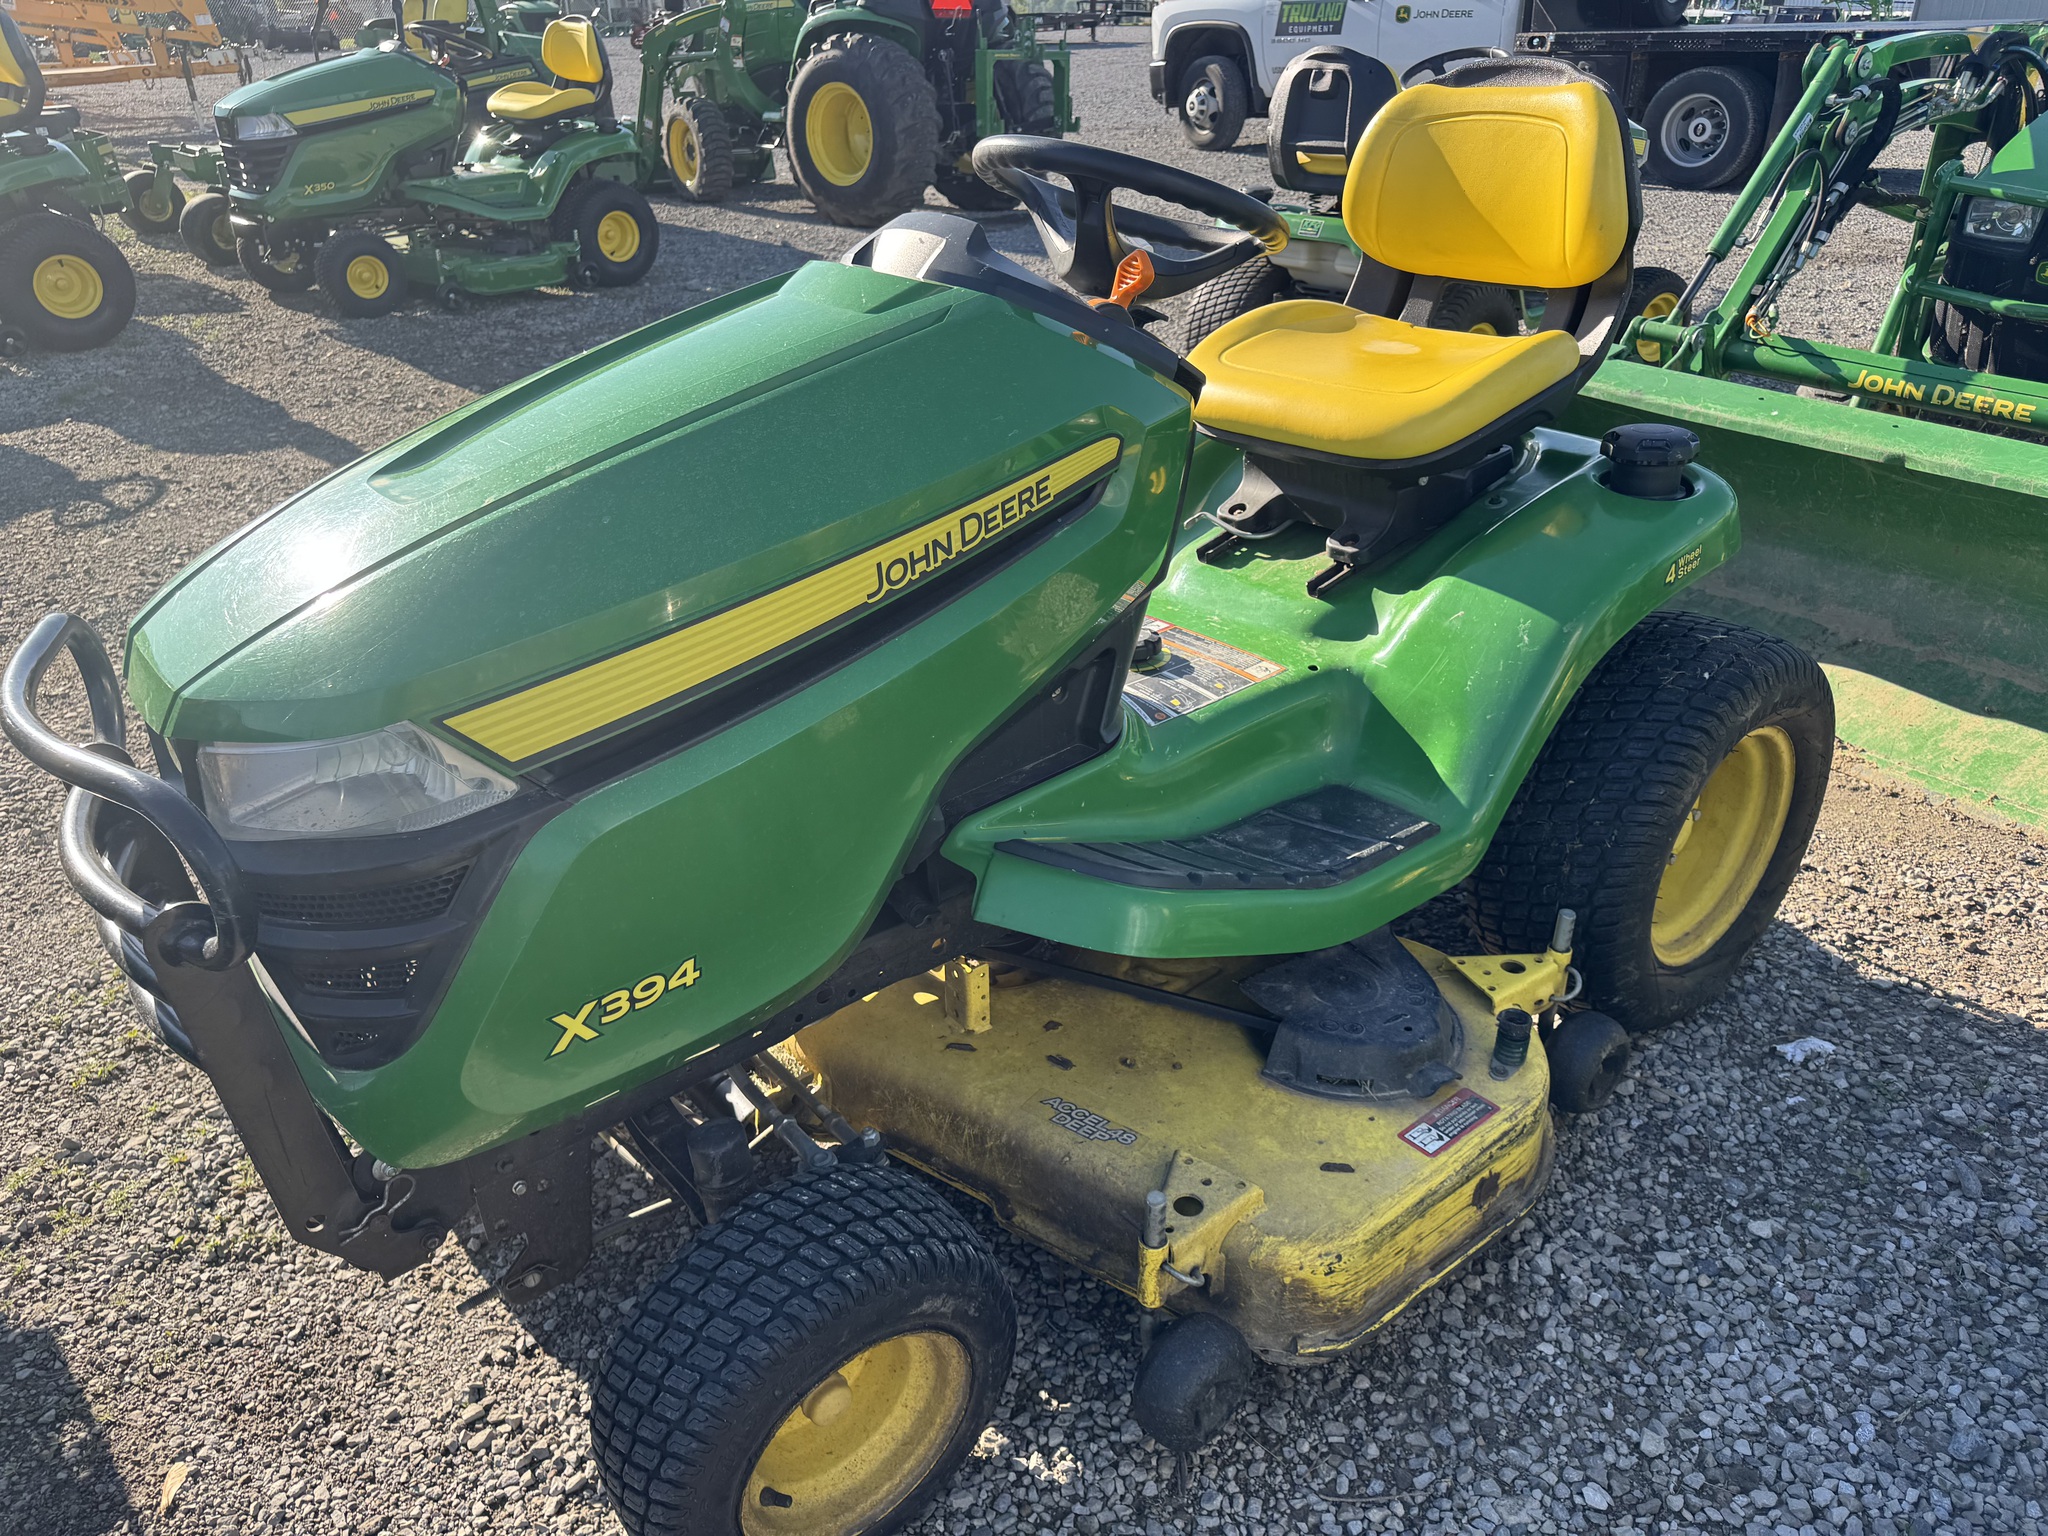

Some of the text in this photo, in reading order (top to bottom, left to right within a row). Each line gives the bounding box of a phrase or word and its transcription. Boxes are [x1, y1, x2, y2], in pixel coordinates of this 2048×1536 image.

[1281, 2, 1344, 24] TRULAND
[1413, 8, 1474, 19] JOHN DEERE
[1288, 24, 1334, 34] EQUIPMENT
[368, 92, 416, 112] JOHN DEERE
[304, 181, 335, 196] X350
[1847, 369, 2037, 424] JOHN DEERE
[866, 474, 1053, 603] JOHN DEERE
[1678, 544, 1703, 567] Wheel
[1665, 563, 1676, 584] 4
[1677, 557, 1701, 579] Steer
[548, 956, 701, 1058] X394
[1438, 1096, 1461, 1114] DANGER
[1041, 1096, 1138, 1145] ACCEL 48
[1049, 1112, 1111, 1140] DEEP
[1436, 1110, 1458, 1125] ROTATING
